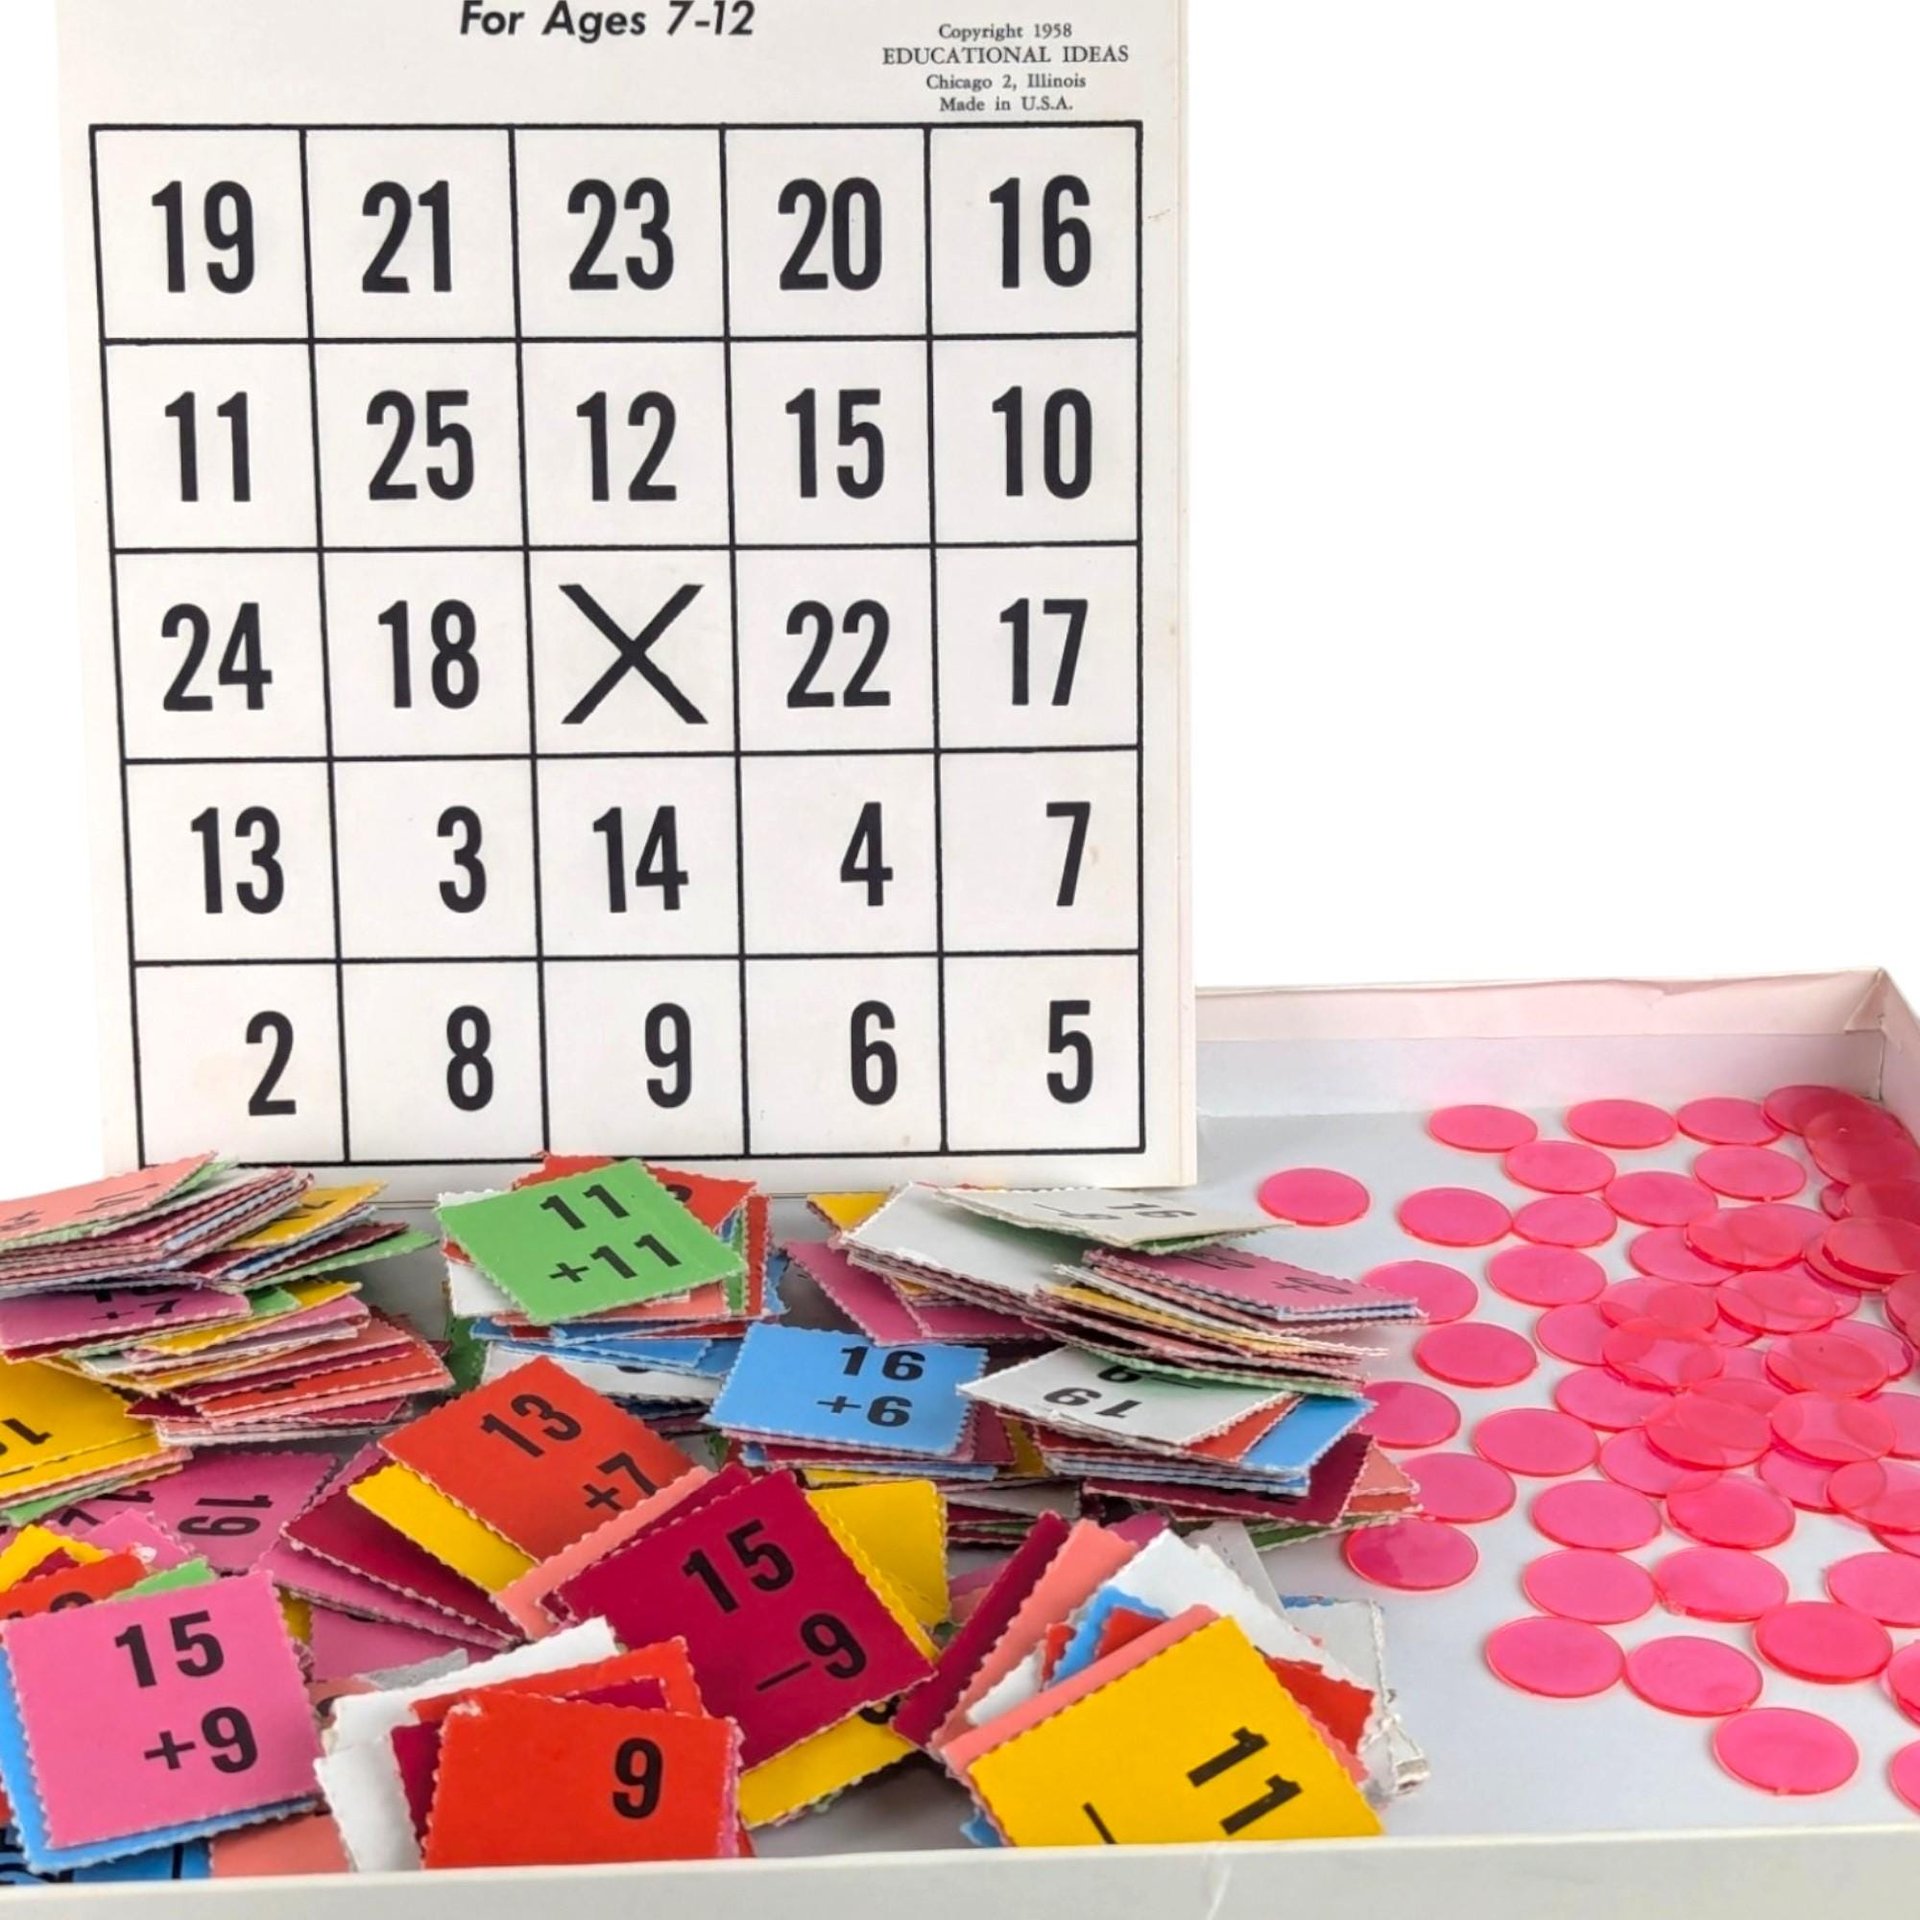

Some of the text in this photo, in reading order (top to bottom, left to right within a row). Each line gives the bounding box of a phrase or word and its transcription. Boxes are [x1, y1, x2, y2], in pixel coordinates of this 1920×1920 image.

[460, 0, 756, 44] For Ages 7-12
[938, 23, 1073, 42] Copyright 1958
[882, 45, 1130, 65] EDUCATIONAL IDEAS
[926, 73, 1087, 92] Chicago 2, Illinois
[939, 96, 1074, 112] Made in U.S.A.
[152, 174, 1091, 294] 19 21 23 20 16
[165, 386, 1093, 502] 11 25 12 15 10
[161, 601, 272, 712] 24
[378, 599, 479, 709] 18
[785, 598, 890, 708] 22
[1000, 597, 1088, 706] 17
[190, 800, 1091, 915] 13 3 14 4 7
[246, 998, 1093, 1116] 2 8 9 6 5
[540, 1184, 630, 1231] 11
[548, 1234, 682, 1284] +11
[841, 1346, 925, 1381] 16
[481, 1394, 582, 1457] 13
[817, 1395, 912, 1427] +6
[1043, 1386, 1142, 1418] 19
[585, 1452, 660, 1511] +7
[178, 1494, 273, 1536] 19
[682, 1519, 794, 1614] 15
[114, 1610, 225, 1689] 15
[144, 1706, 257, 1774] +9
[612, 1737, 663, 1820] 9
[1187, 1727, 1303, 1836] 11
